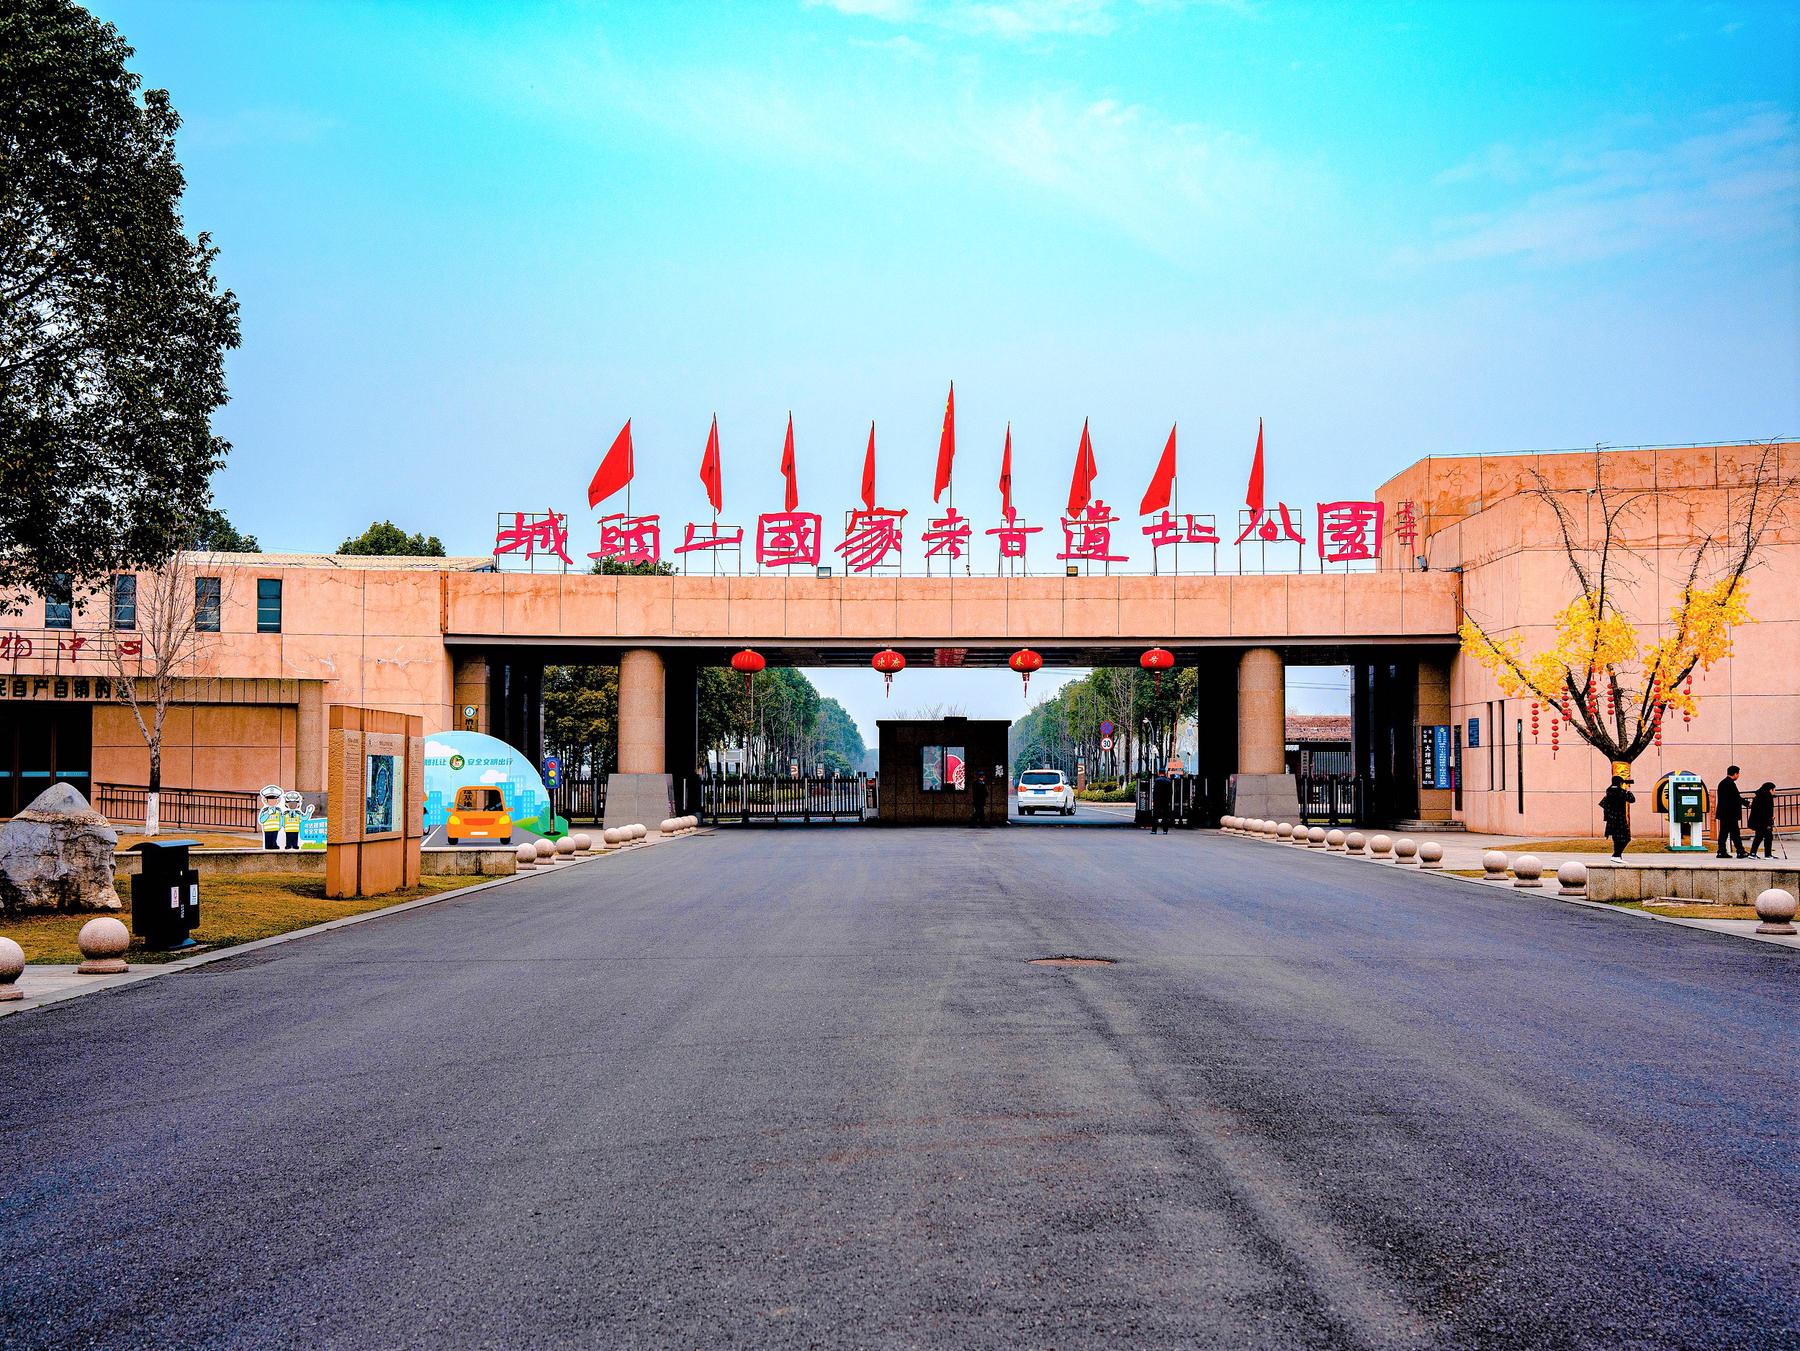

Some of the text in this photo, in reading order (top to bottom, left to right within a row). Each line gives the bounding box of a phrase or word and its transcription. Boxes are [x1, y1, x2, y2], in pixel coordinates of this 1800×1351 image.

[1102, 739, 1111, 749] 30
[467, 758, 513, 766] 安全文明出行
